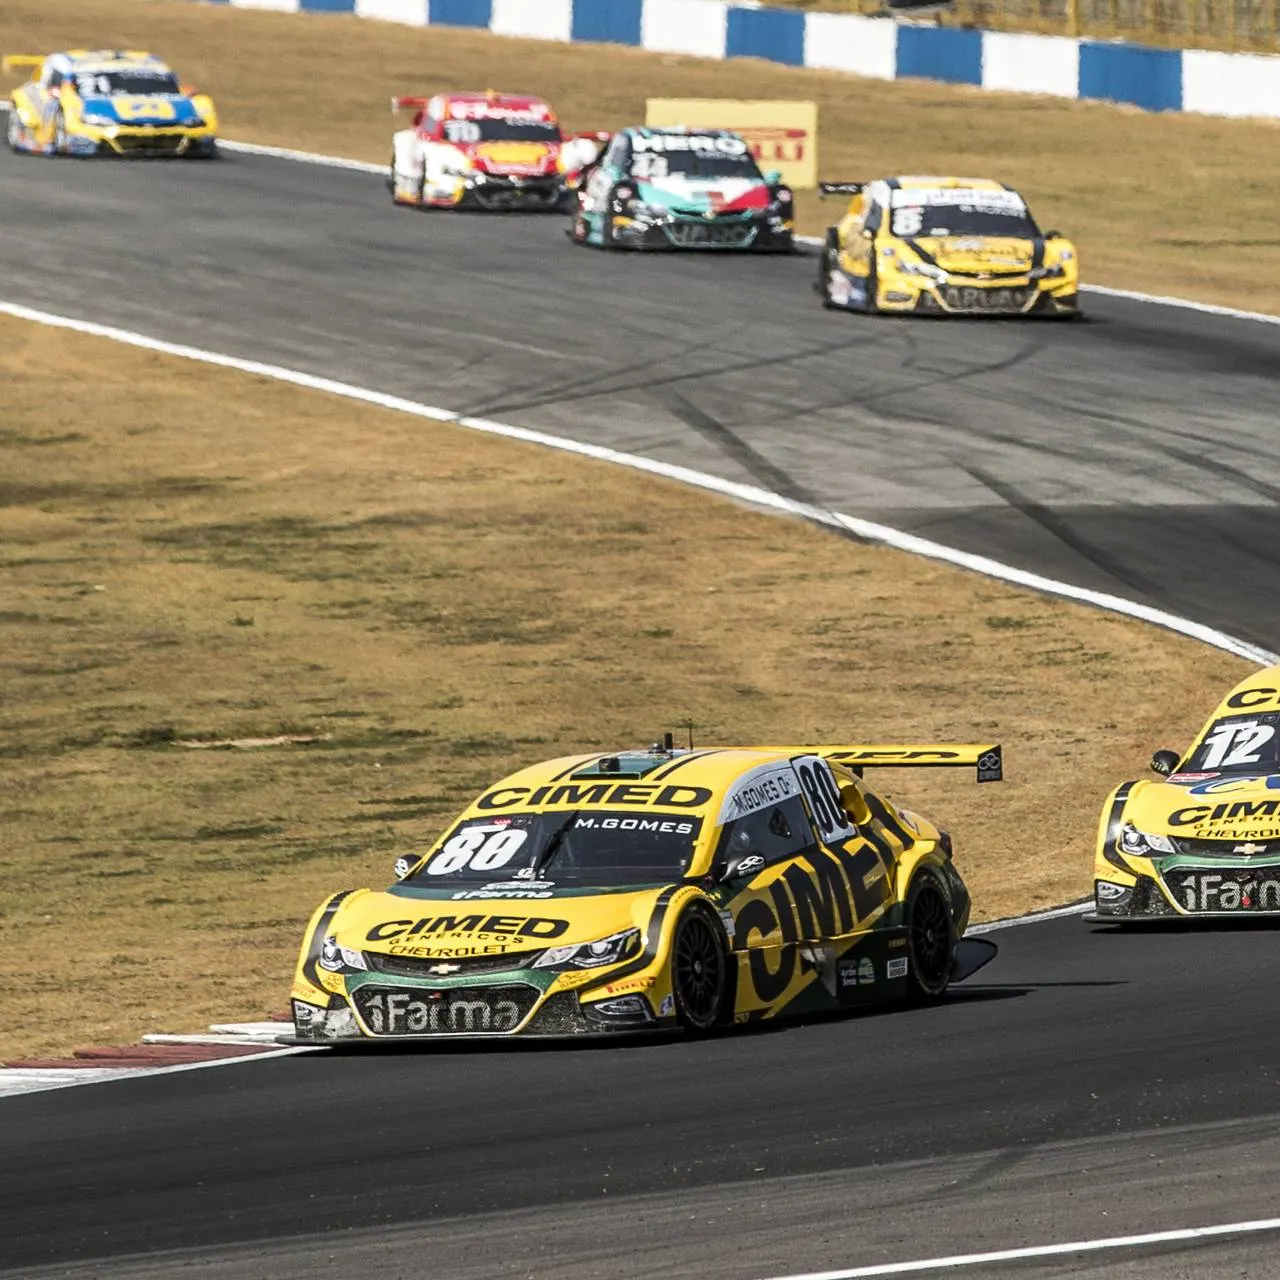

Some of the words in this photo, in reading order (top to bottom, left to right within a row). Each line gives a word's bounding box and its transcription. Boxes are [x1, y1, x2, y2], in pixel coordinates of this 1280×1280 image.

[1201, 721, 1276, 770] 12
[477, 784, 713, 810] CIMED
[574, 818, 693, 835] M.GOMES
[425, 826, 528, 875] 80
[366, 915, 570, 941] CIMED
[389, 944, 511, 957] CHEVROLET
[366, 993, 519, 1032] 1Farma
